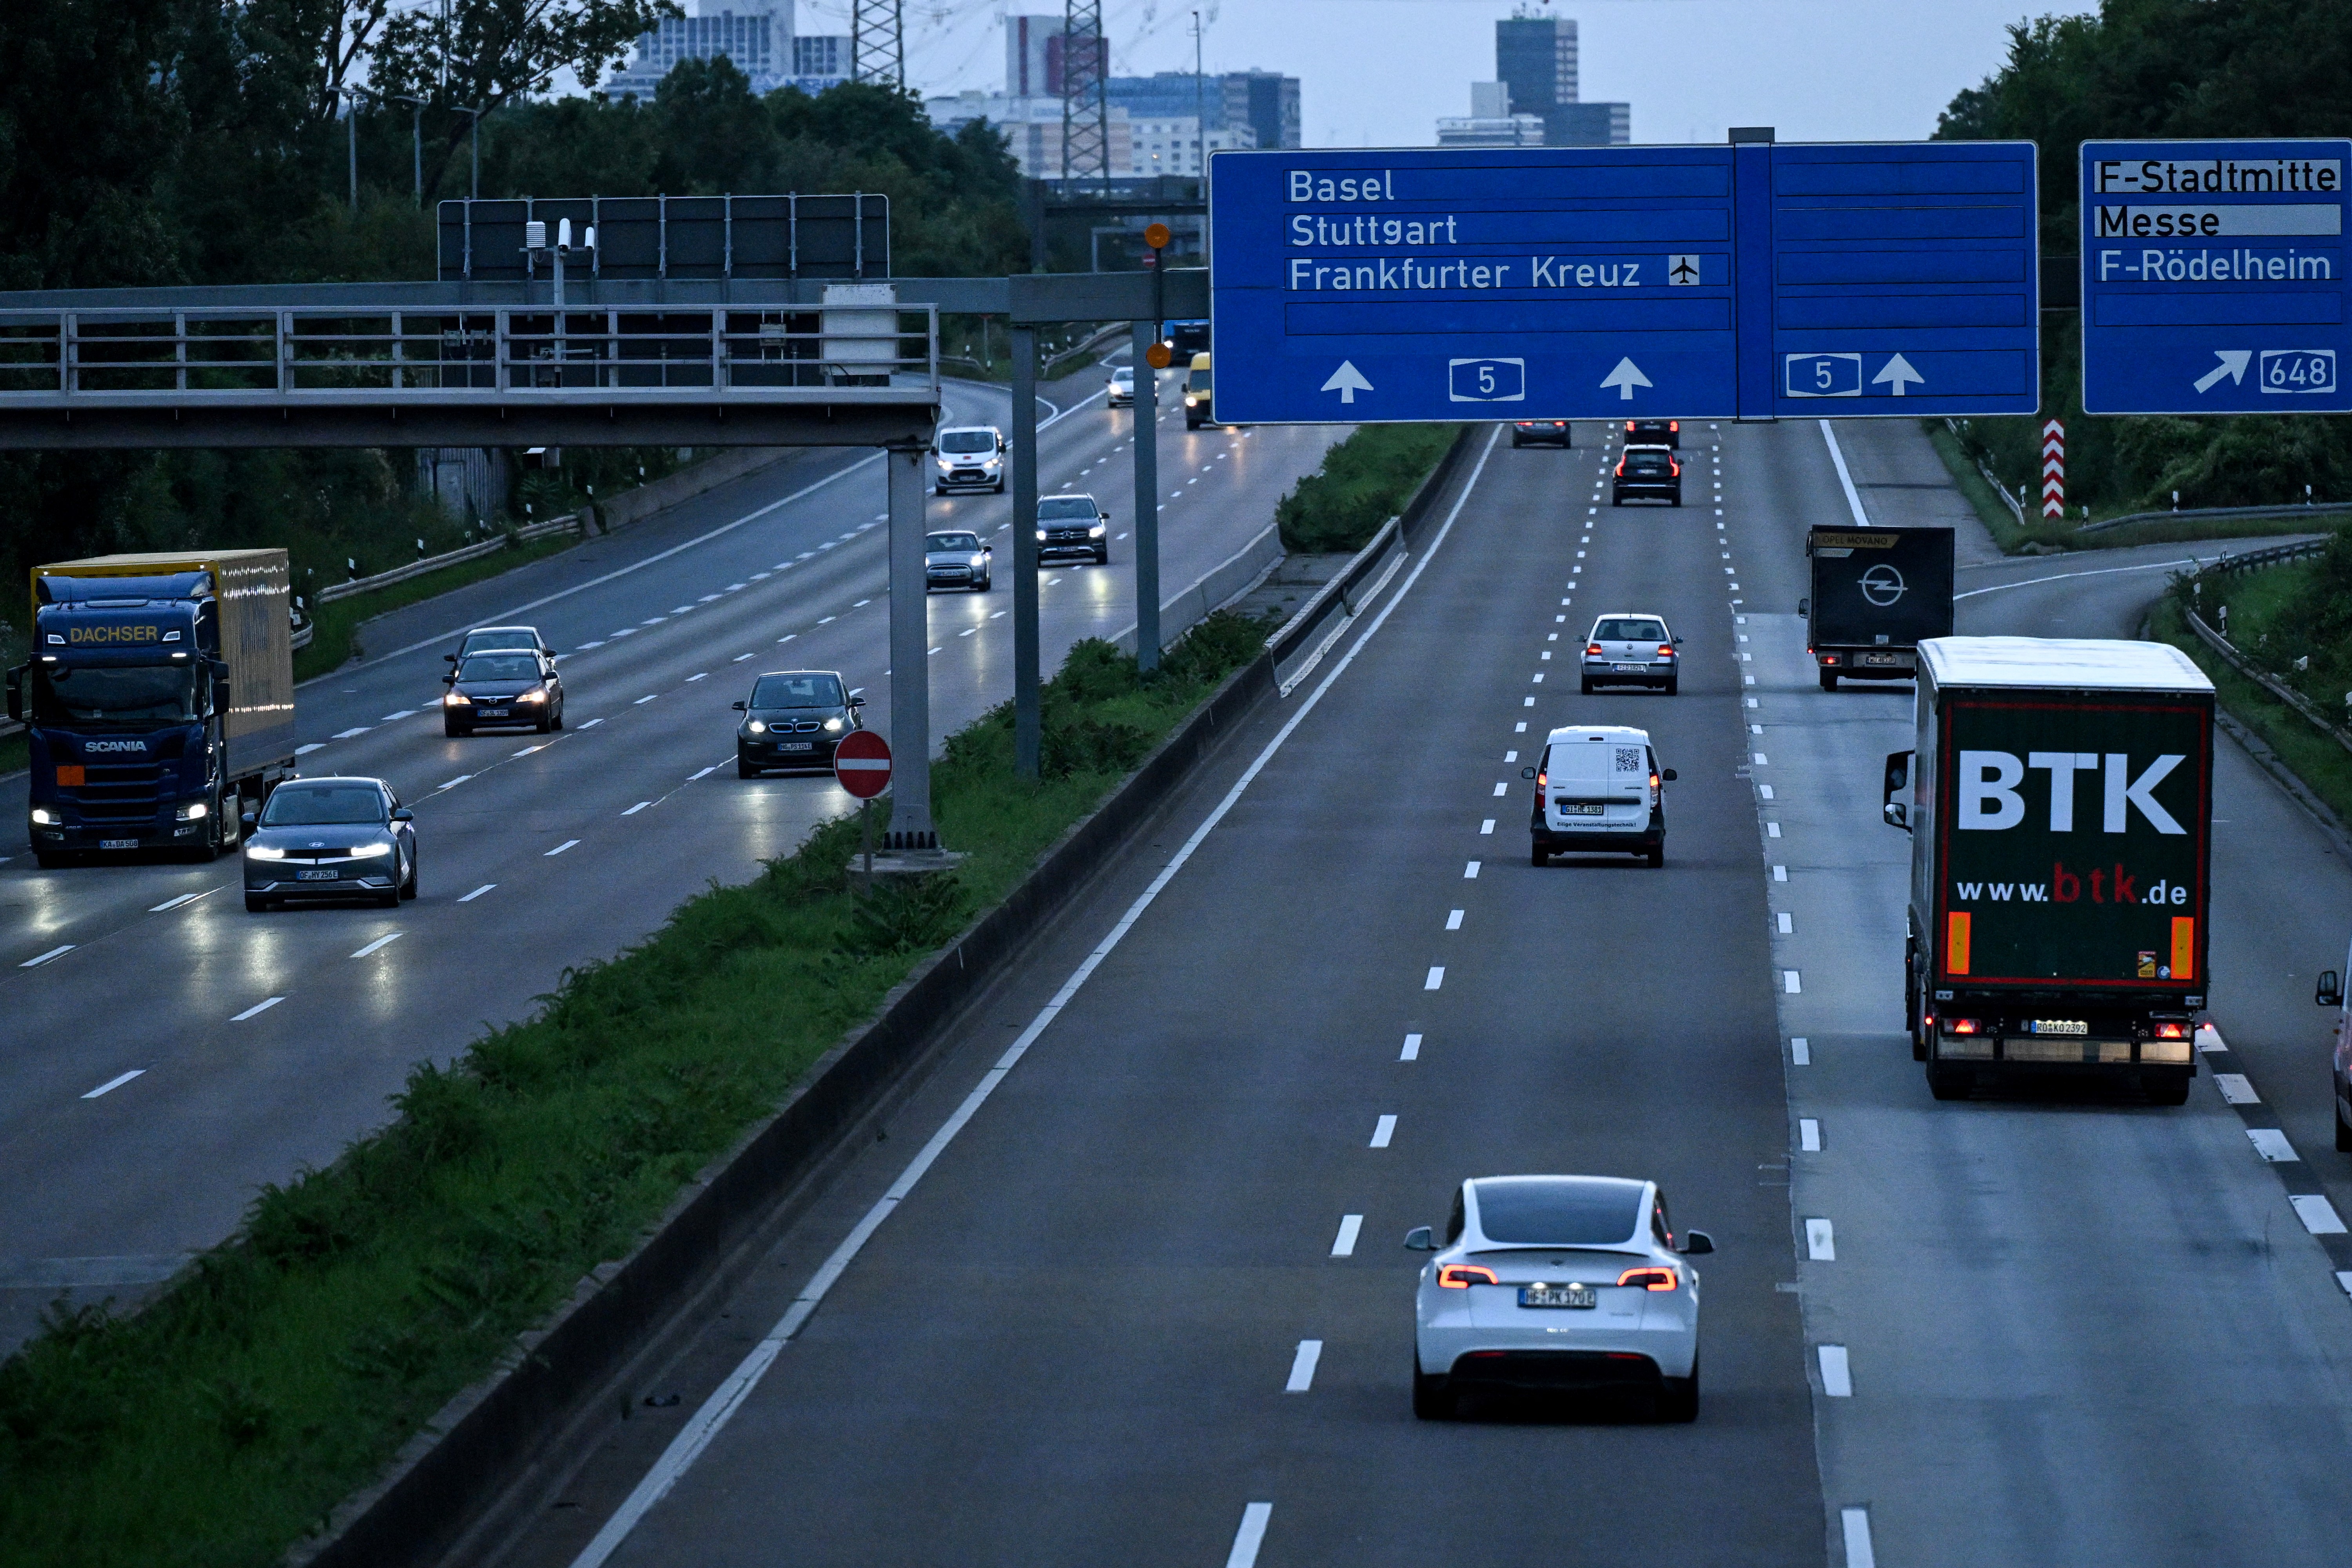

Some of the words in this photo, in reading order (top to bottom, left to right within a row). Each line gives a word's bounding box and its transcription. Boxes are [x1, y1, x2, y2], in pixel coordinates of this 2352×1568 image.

[1291, 170, 1394, 202] Basel
[2101, 160, 2336, 192] F-Stadtmitte
[1292, 215, 1457, 246] Stuttgart
[2100, 205, 2220, 236] Messe
[1292, 258, 1510, 290] Frankfurter
[1532, 256, 1640, 287] Kreuz
[2101, 249, 2330, 281] F-Rödelheim
[1479, 366, 1495, 393] 5
[1816, 361, 1832, 388] 5
[2270, 358, 2326, 385] 648
[1823, 535, 1844, 544] OPEL
[1847, 536, 1888, 545] MOVANO
[70, 626, 157, 642] DACHSER
[85, 741, 147, 752] SCANIA
[1958, 750, 2187, 835] BTK
[1956, 863, 2187, 905] www.btk.de
